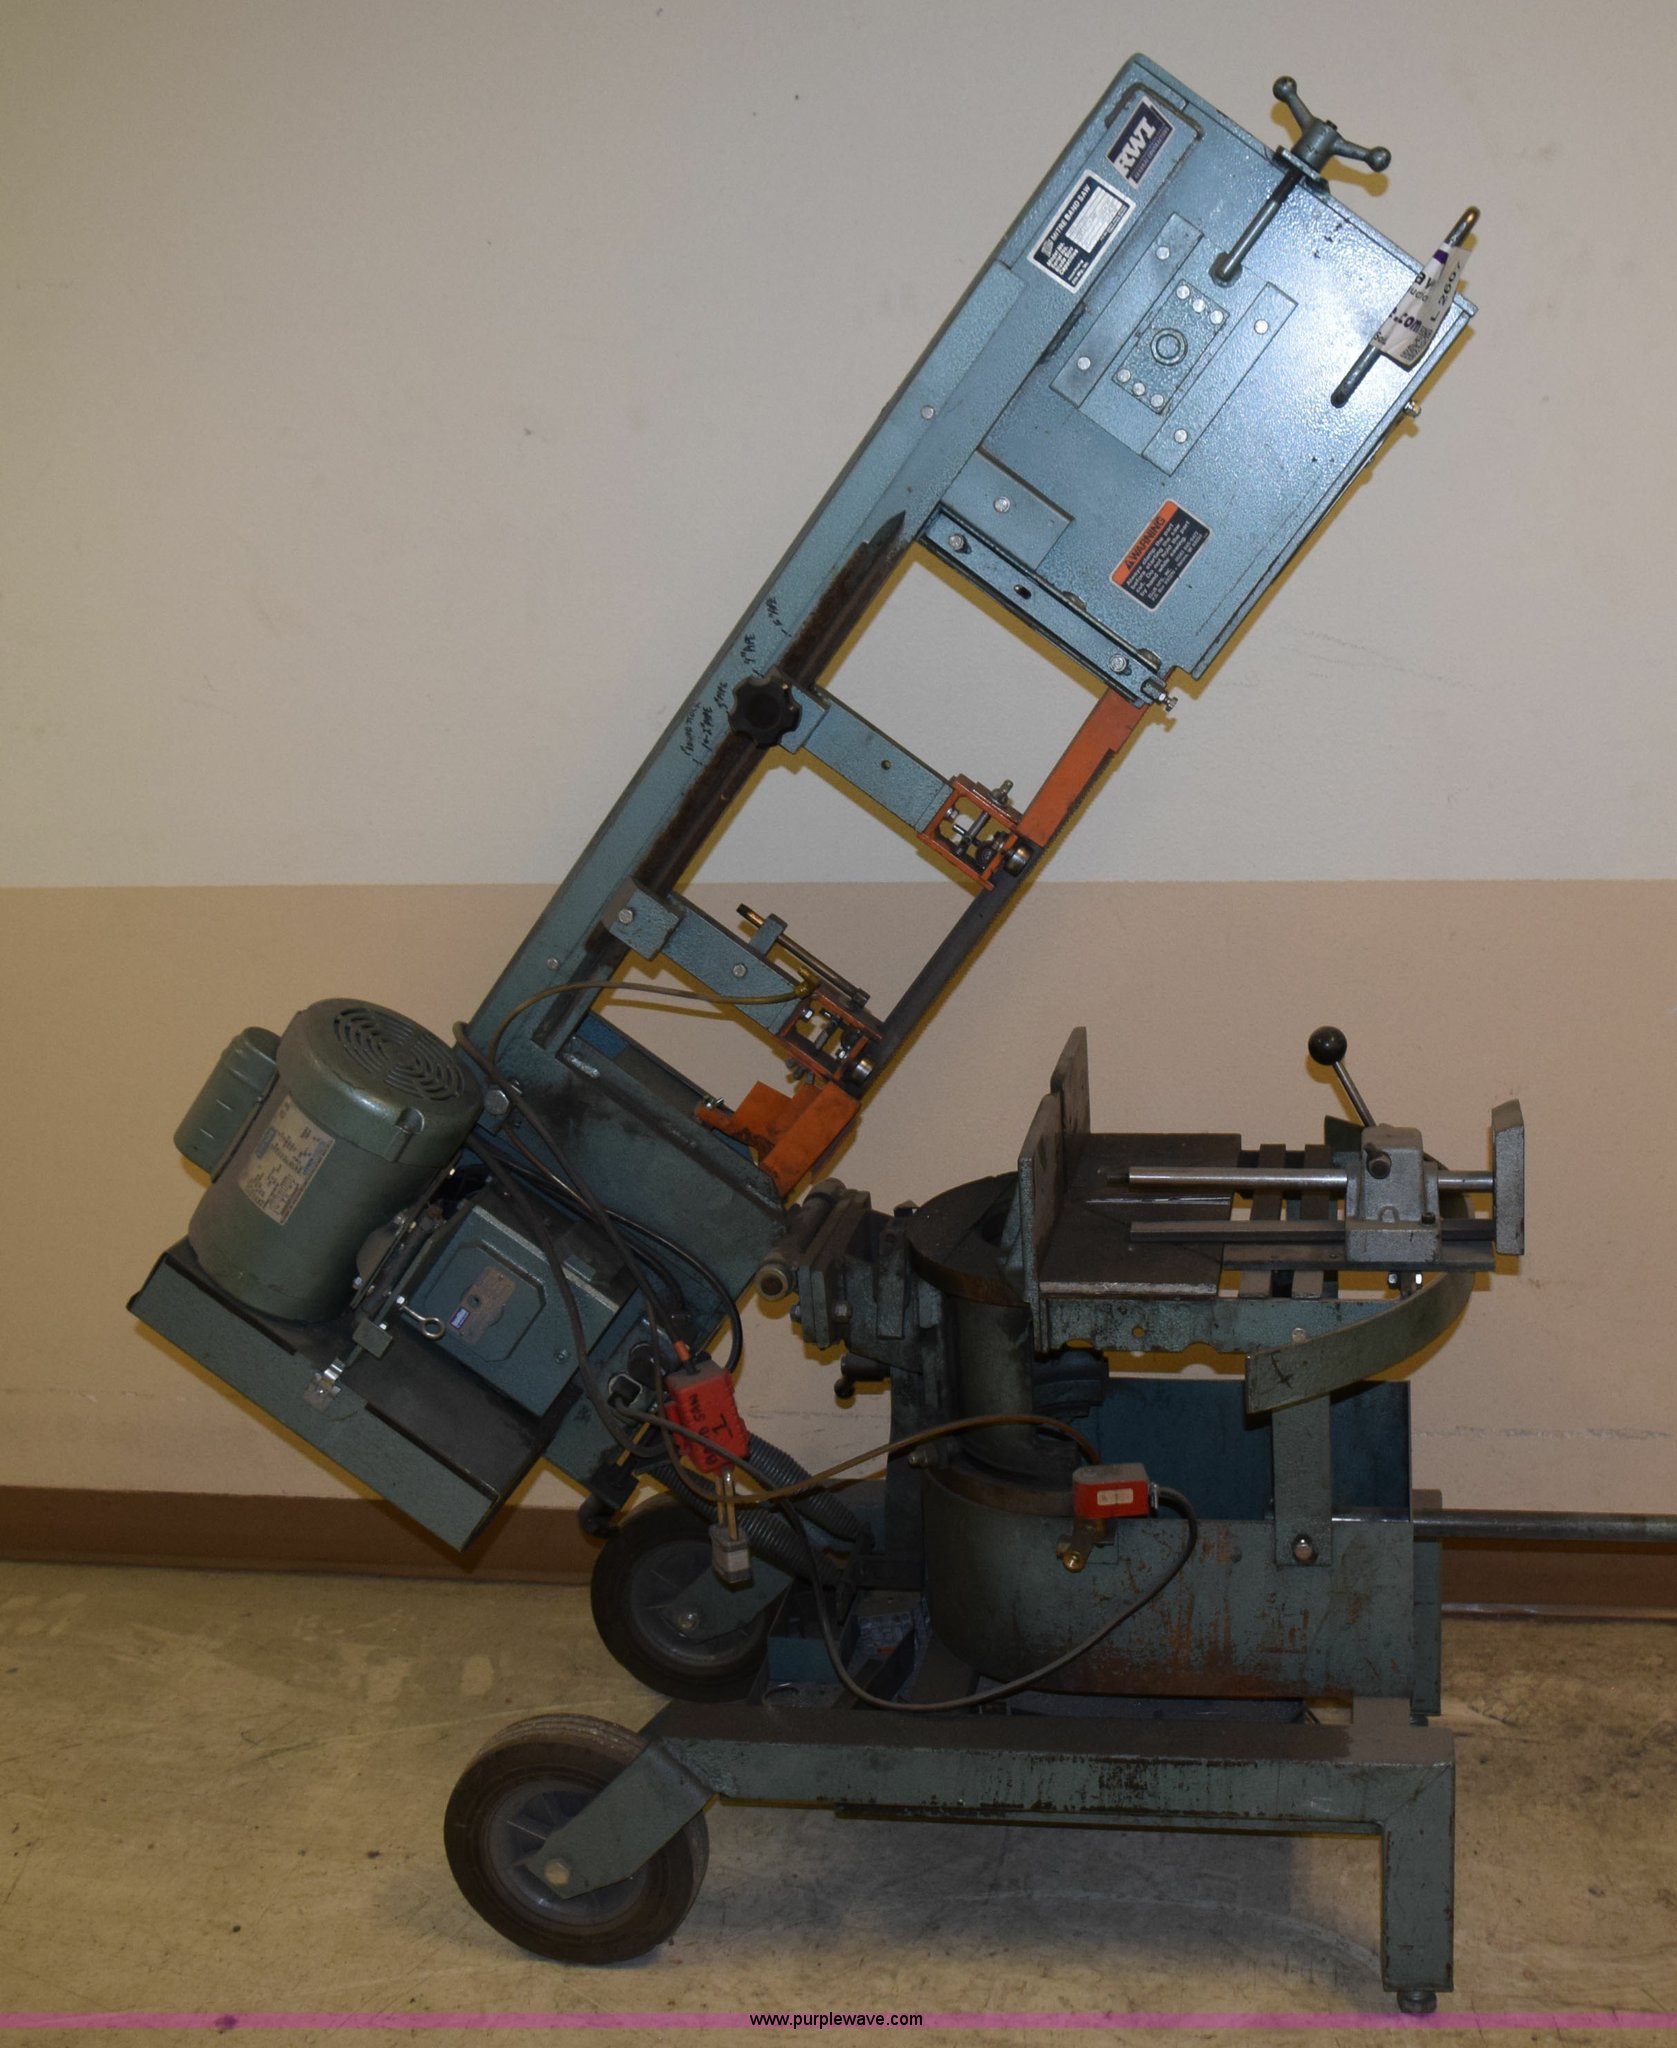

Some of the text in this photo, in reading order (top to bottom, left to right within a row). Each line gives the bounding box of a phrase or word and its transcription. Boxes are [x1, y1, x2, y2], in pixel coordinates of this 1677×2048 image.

[1113, 116, 1156, 177] RWI
[1050, 184, 1091, 242] MITRE BAND SAW
[1131, 515, 1166, 562] WARNING
